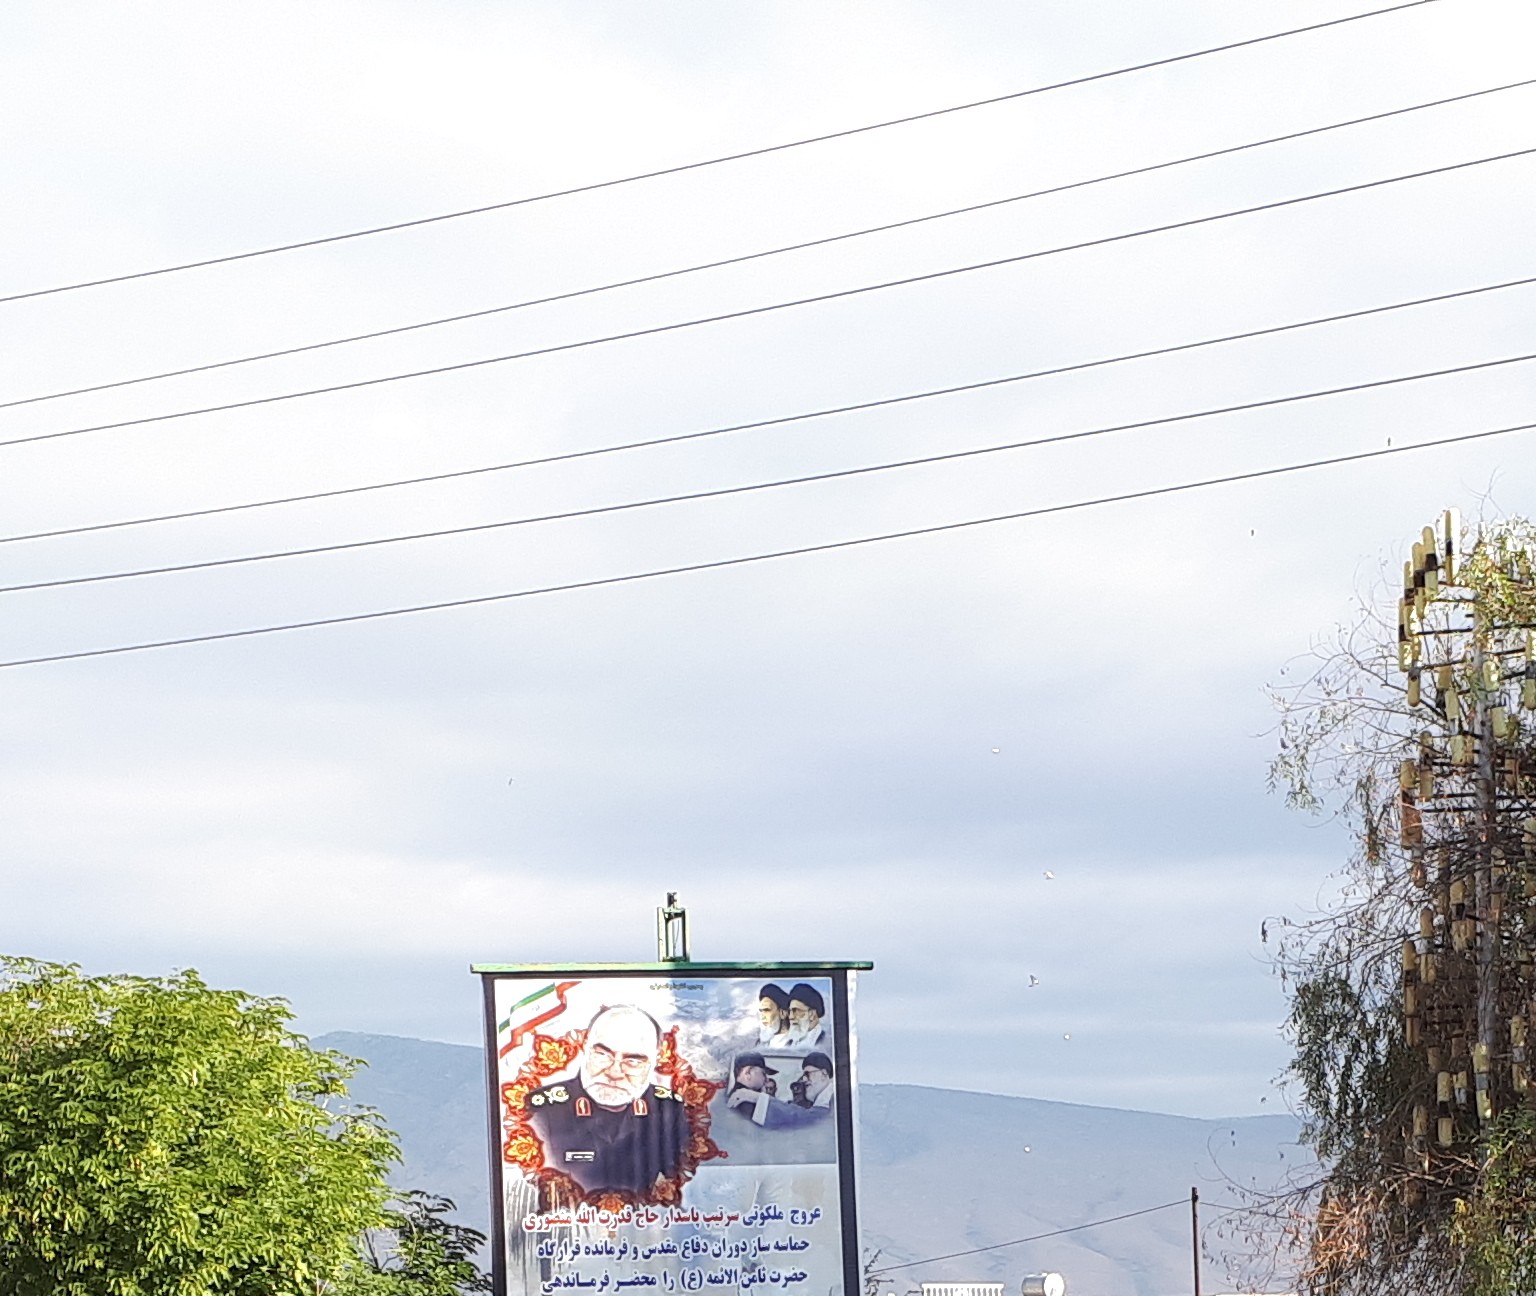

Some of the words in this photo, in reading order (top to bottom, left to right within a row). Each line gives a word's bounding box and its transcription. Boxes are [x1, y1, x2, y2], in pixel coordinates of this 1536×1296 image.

[524, 1210, 572, 1230] منصوری
[576, 1203, 595, 1224] الله
[599, 1207, 632, 1229] قدرت
[636, 1208, 659, 1228] حاج
[663, 1207, 699, 1228] پاسدار
[703, 1207, 739, 1228] سرتیپ
[743, 1205, 784, 1226] ملکوتی
[790, 1207, 821, 1224] عروج
[584, 1239, 628, 1260] فرمانده
[632, 1246, 640, 1260] و
[642, 1240, 678, 1259] مقدس
[681, 1237, 708, 1258] دفاع
[712, 1238, 747, 1258] دوران
[752, 1237, 770, 1257] ساز
[774, 1236, 809, 1251] حماسه
[664, 1271, 675, 1290] را
[707, 1268, 738, 1285] الائمه
[741, 1266, 766, 1288] ثامن
[770, 1267, 808, 1288] حضرت
